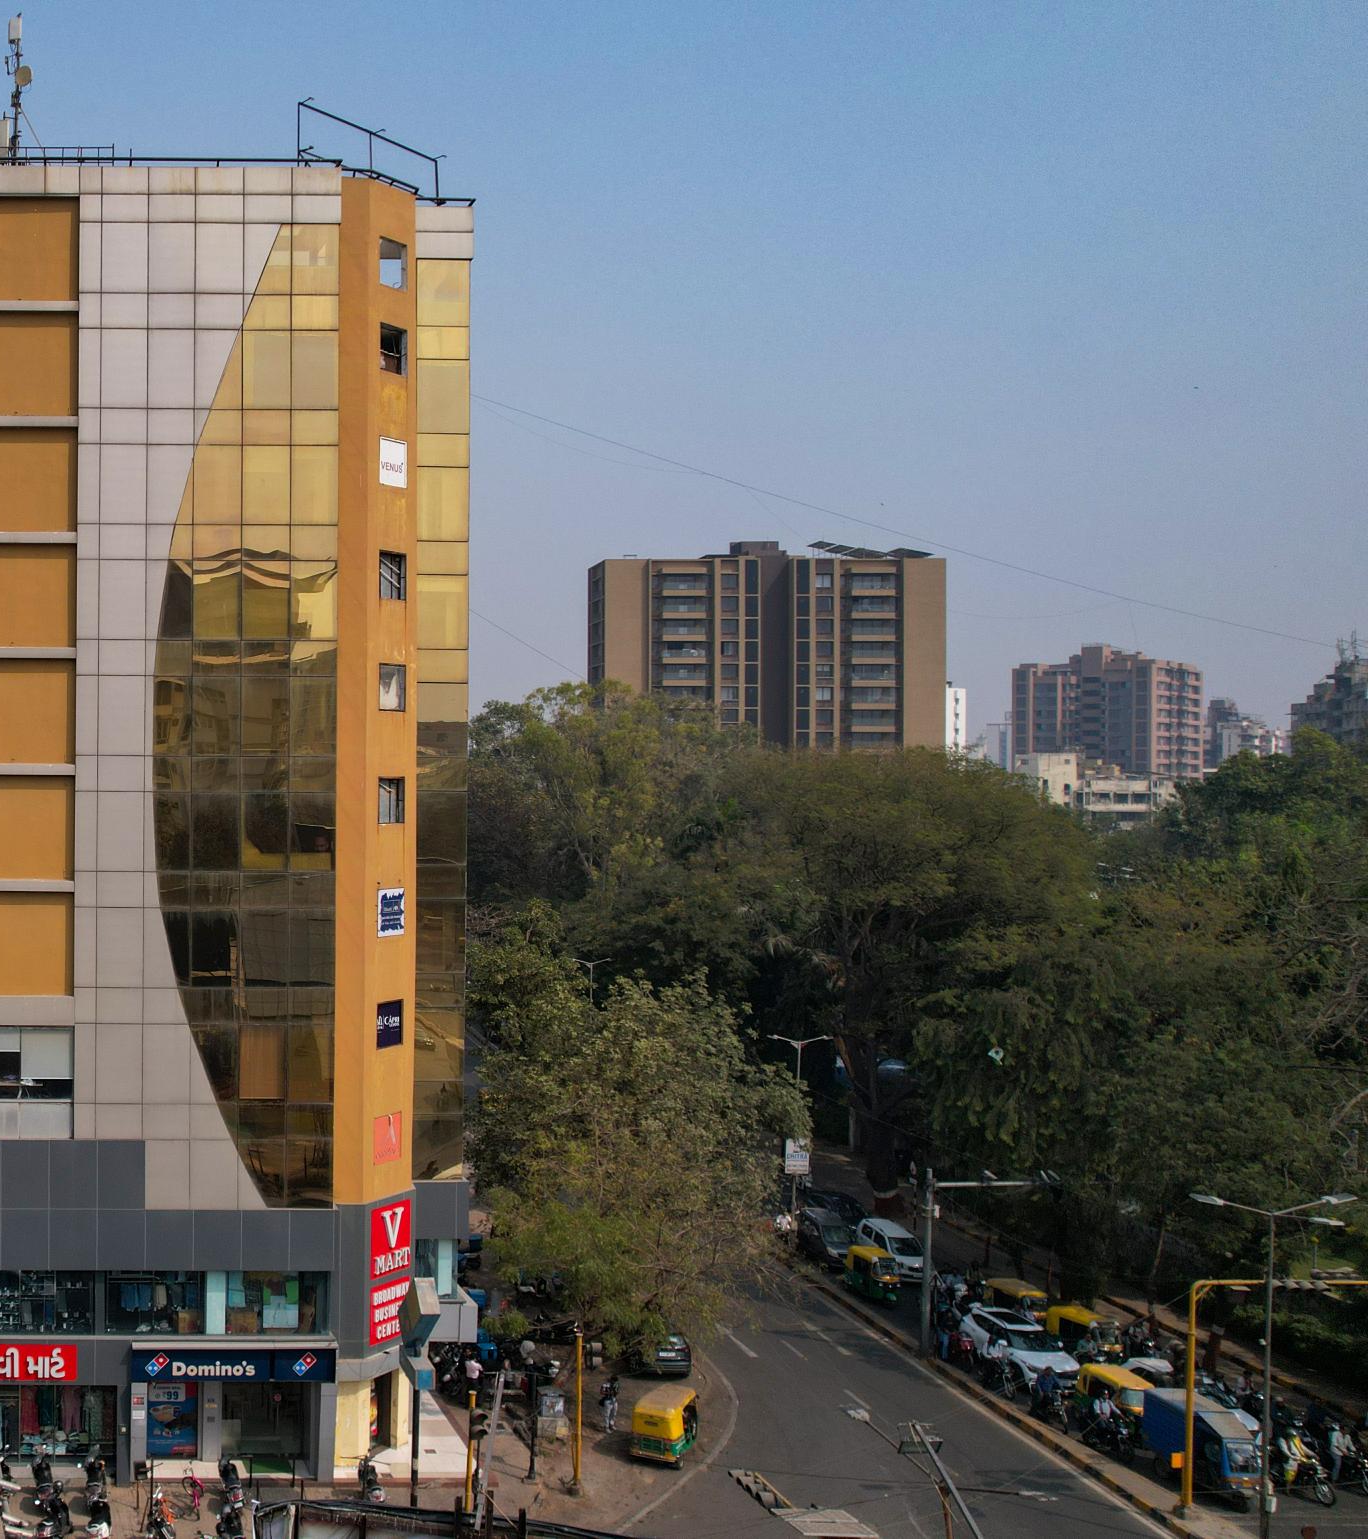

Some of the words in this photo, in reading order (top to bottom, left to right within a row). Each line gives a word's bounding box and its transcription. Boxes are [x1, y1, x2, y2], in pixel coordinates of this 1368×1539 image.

[381, 461, 403, 474] VENUS
[381, 1206, 405, 1249] V
[375, 1246, 411, 1275] MART
[373, 1281, 410, 1306] BROADWAY
[376, 1319, 401, 1340] CENTE
[26, 1347, 66, 1378] માર્ટ
